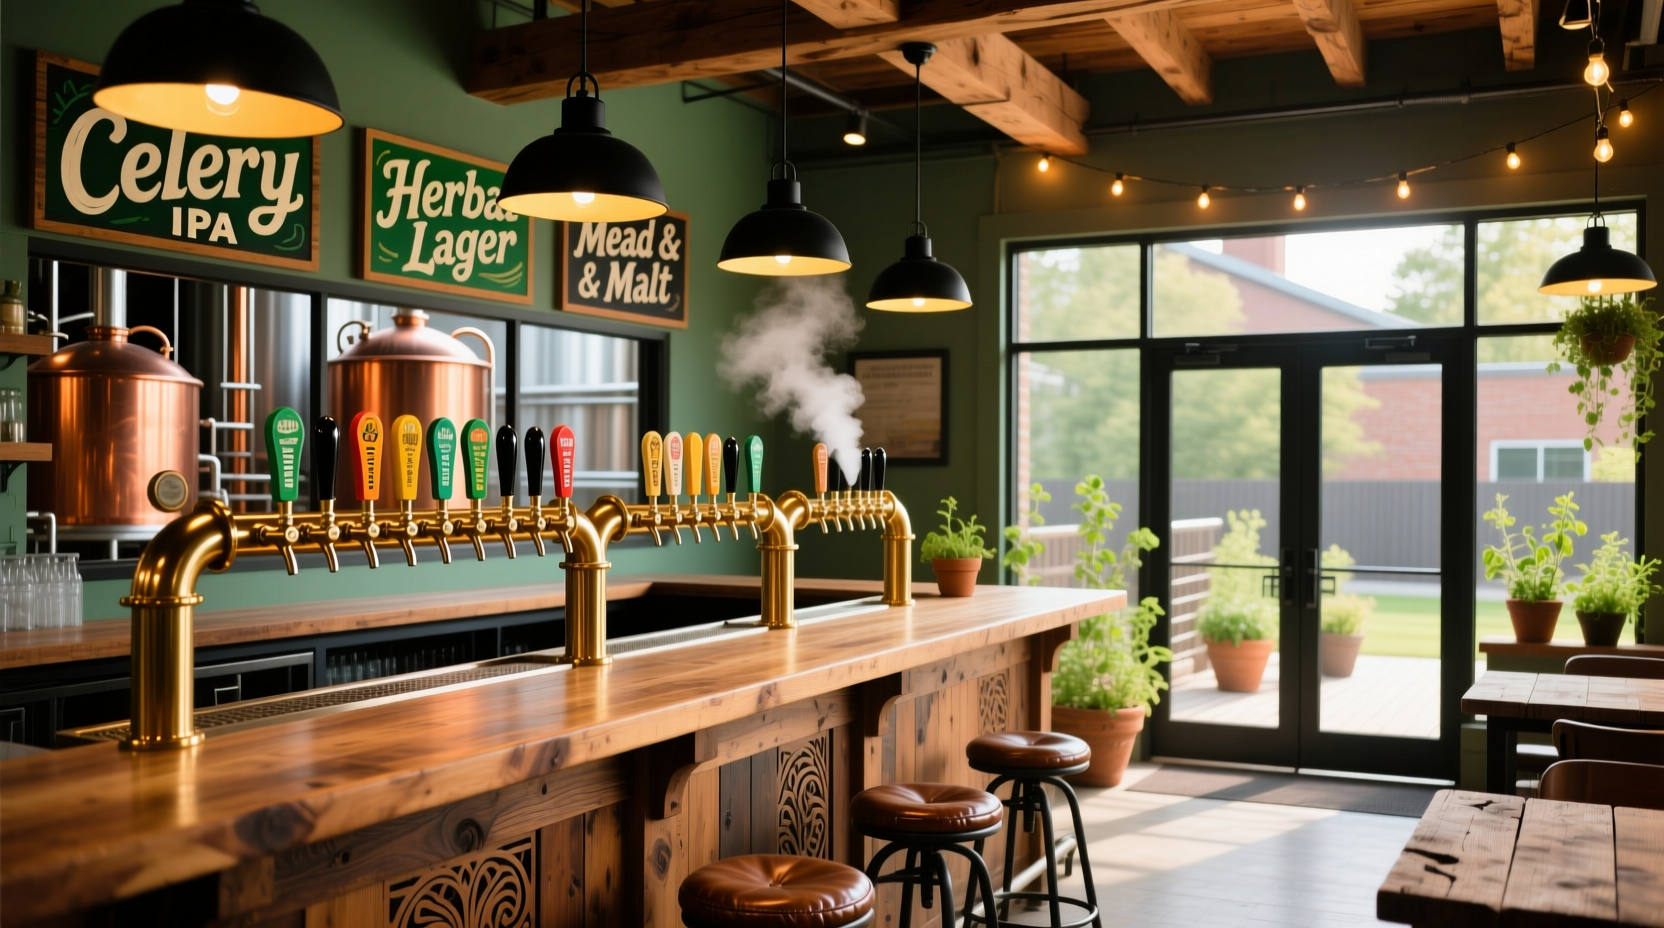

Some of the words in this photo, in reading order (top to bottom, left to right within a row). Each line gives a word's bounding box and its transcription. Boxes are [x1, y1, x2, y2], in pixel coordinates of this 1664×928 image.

[61, 107, 304, 236] Celery
[376, 159, 519, 228] Herba
[172, 206, 238, 244] IPA
[573, 219, 656, 259] Mead
[658, 223, 681, 261] &
[401, 221, 517, 282] Lager
[578, 261, 600, 299] &
[603, 261, 673, 304] Malt
